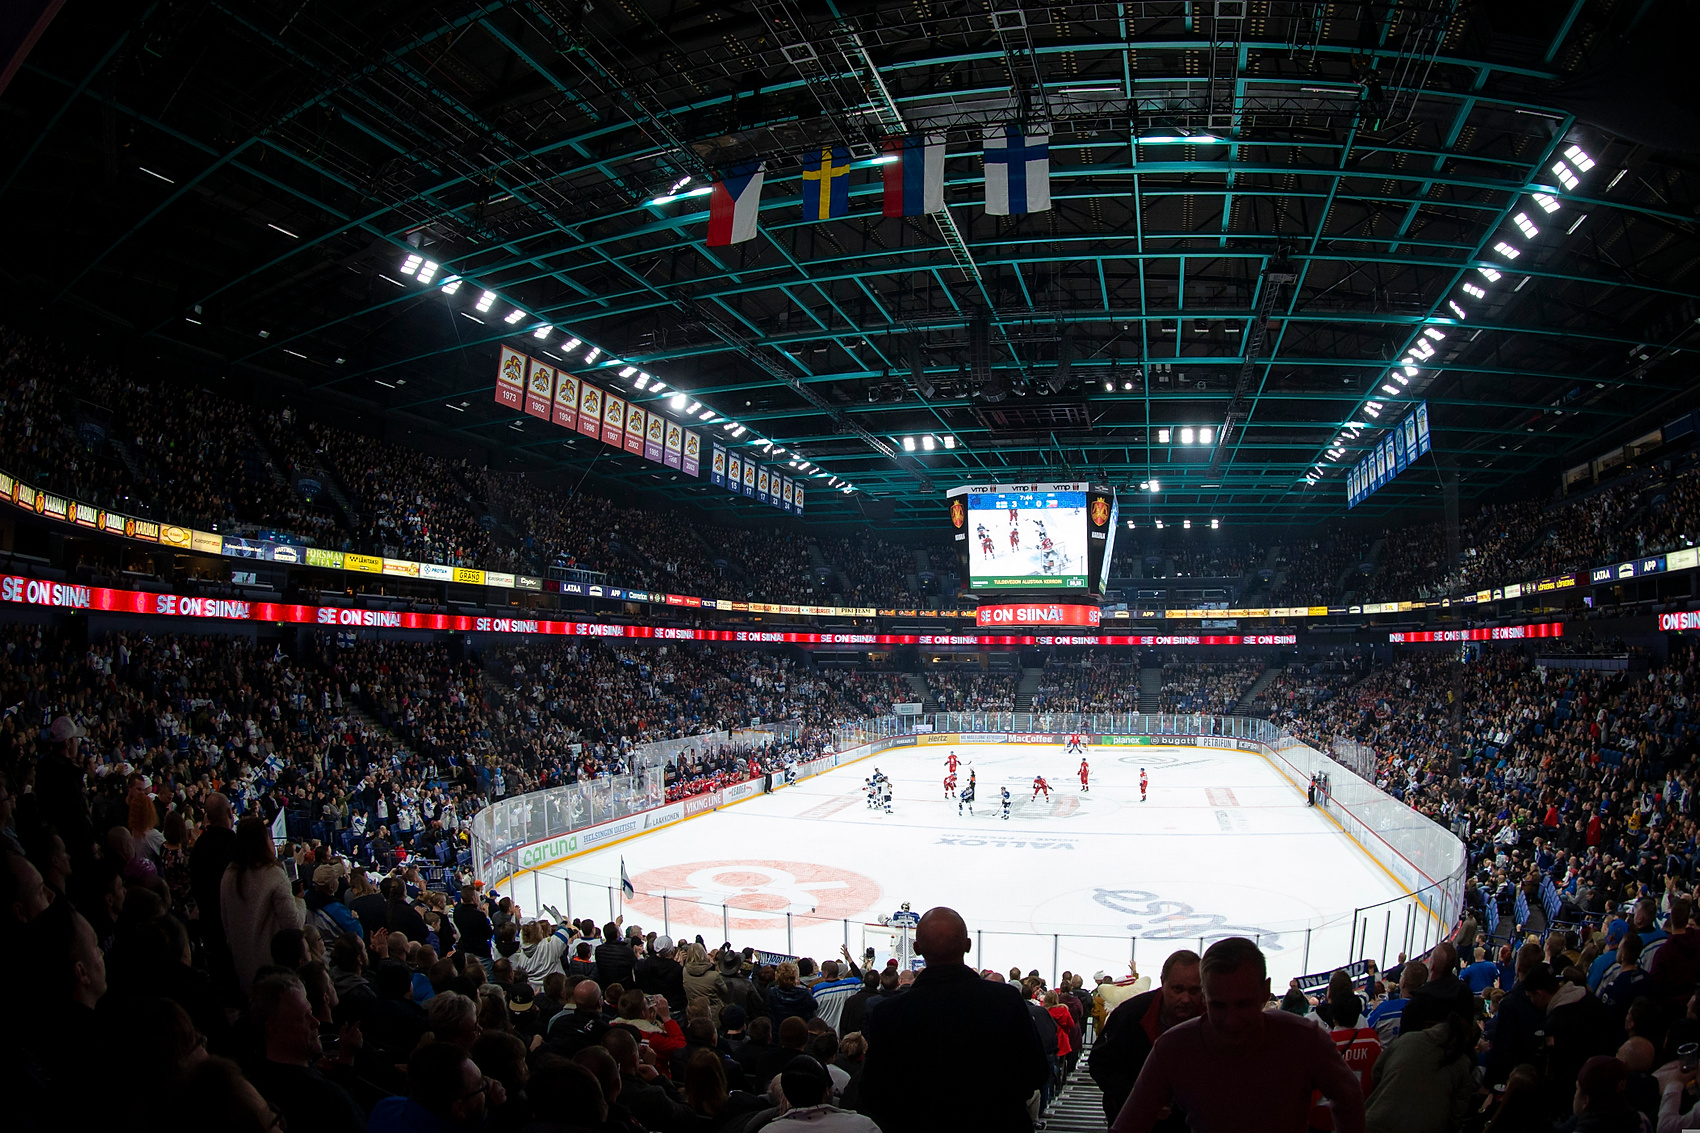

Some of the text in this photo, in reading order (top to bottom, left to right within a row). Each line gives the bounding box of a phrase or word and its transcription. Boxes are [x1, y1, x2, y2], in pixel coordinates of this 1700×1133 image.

[502, 390, 516, 402] 1973
[532, 402, 545, 414] 1992
[559, 412, 572, 422] 1994
[584, 422, 595, 432] 1996
[607, 432, 618, 440] 1997
[628, 440, 639, 450] 2002
[716, 475, 721, 483] 5
[730, 482, 738, 490] 15
[746, 487, 752, 495] 17
[19, 484, 36, 506] KARJALA
[44, 494, 67, 516] KARJALA
[1036, 500, 1042, 508] 0
[76, 504, 98, 524] KARJALA
[106, 512, 126, 531] KARJALA
[136, 520, 159, 538] KARJALA
[306, 548, 344, 561] FORSMAN
[316, 558, 330, 568] TEA
[1644, 560, 1656, 572] APP
[459, 572, 480, 581] GRAND
[1593, 570, 1610, 581] LATAA
[2, 577, 90, 608] SE ON SIINÄ!
[564, 583, 582, 593] LATAA
[611, 590, 621, 598] APP
[156, 594, 250, 618] SE ON SIINÄ!
[317, 608, 400, 628] SE ON SIINÄ!
[981, 610, 992, 622] SE
[994, 609, 1013, 621] ON
[1017, 606, 1064, 621] SIINÄ!
[1088, 610, 1098, 622] SE
[476, 618, 538, 633] SE ON SIINÄ!
[1662, 614, 1678, 630] ON
[576, 624, 588, 635] SE
[588, 624, 602, 636] ON
[654, 628, 664, 638] SE
[664, 628, 676, 638] ON
[1434, 632, 1444, 641] SE
[1444, 631, 1454, 640] ON
[1492, 628, 1500, 639] SE
[1500, 627, 1508, 638] ON
[736, 632, 747, 641] SE
[748, 632, 760, 642] ON
[820, 634, 832, 642] SE
[834, 634, 850, 643] ON
[918, 636, 932, 644] SE
[934, 636, 949, 644] ON
[1040, 636, 1052, 644] SE
[1055, 636, 1070, 644] ON
[1140, 636, 1154, 644] SE
[1156, 636, 1171, 644] ON
[1243, 636, 1256, 644] SE
[1258, 636, 1272, 644] ON
[1008, 734, 1052, 744] MacCoffee
[1162, 736, 1197, 745] bugatti
[1204, 738, 1232, 748] PETRIFUN
[731, 784, 746, 797] LEADER
[686, 794, 722, 813] VIKING LINE
[652, 812, 680, 826] LAAKKONEN
[584, 820, 637, 843] HELSINGIN UUTISET
[933, 838, 1075, 850] VALLOX
[523, 836, 578, 866] caruna
[1298, 961, 1365, 989] INLND
[1342, 1048, 1368, 1061] OUK
